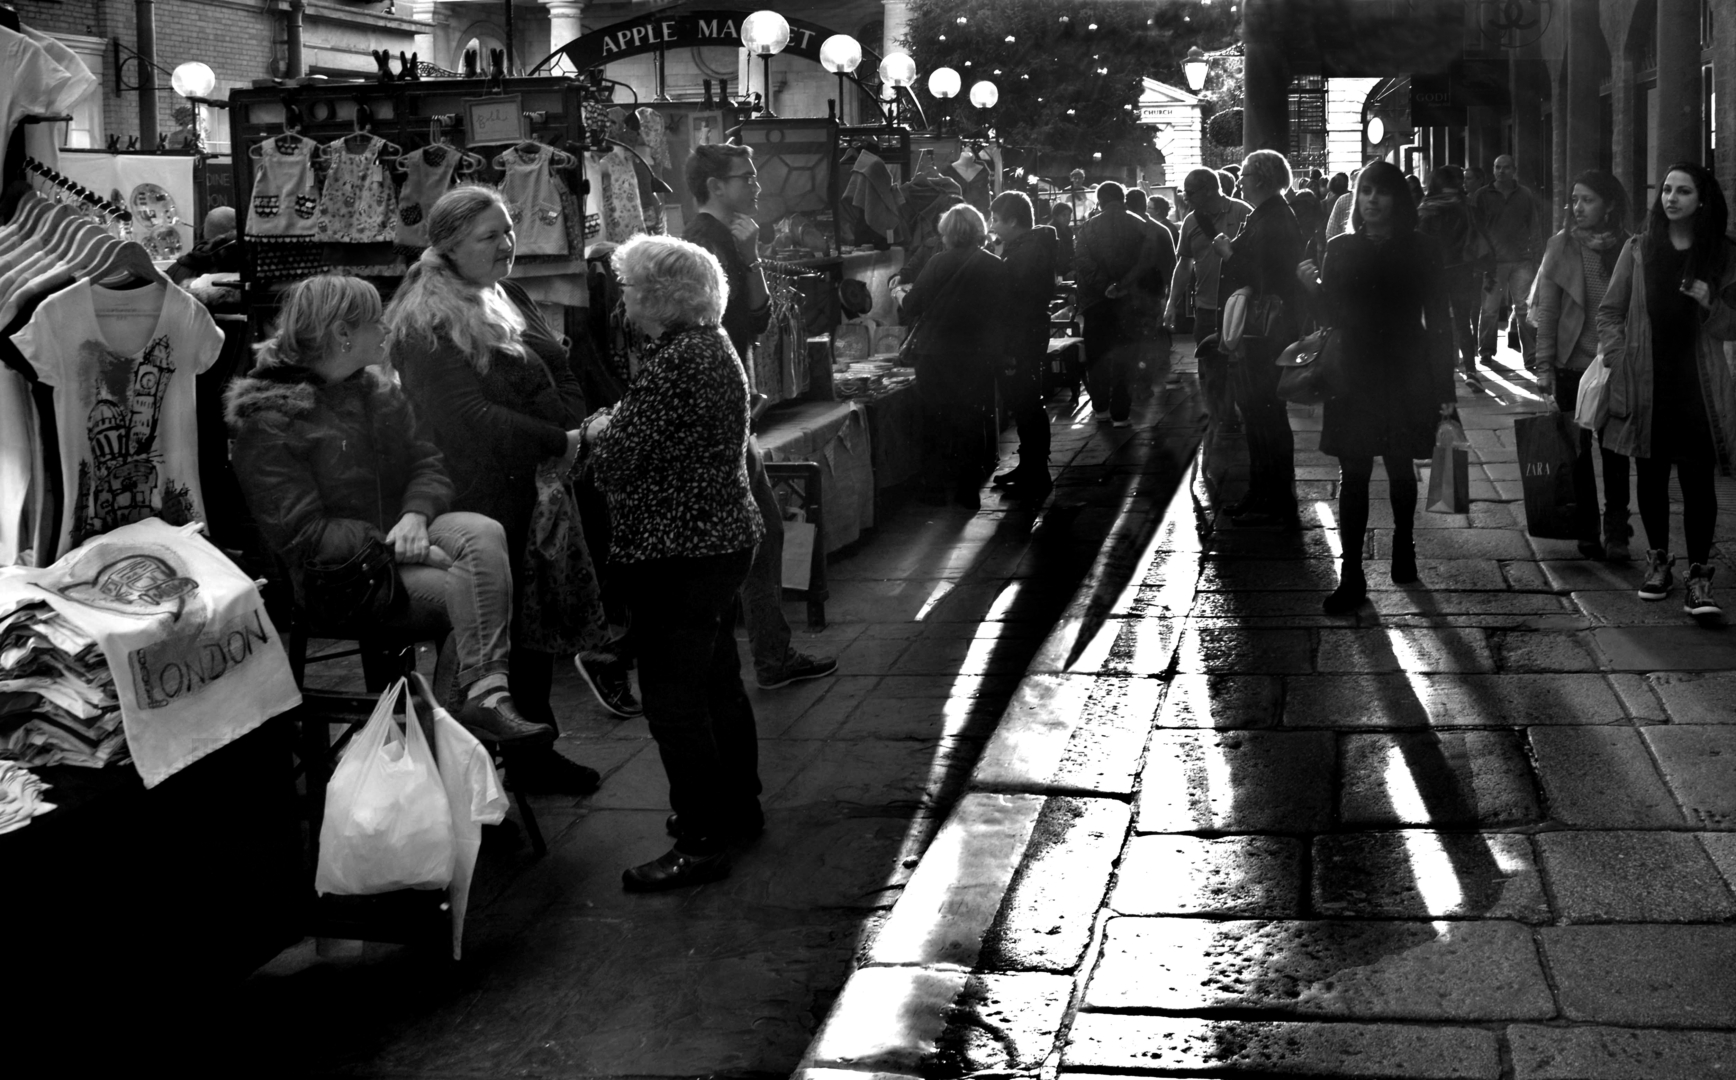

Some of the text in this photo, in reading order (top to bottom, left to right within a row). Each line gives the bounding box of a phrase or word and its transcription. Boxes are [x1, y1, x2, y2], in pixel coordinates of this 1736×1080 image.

[601, 18, 816, 57] APPLE MAET
[1415, 92, 1449, 102] GODI
[1525, 460, 1550, 476] ZARA
[135, 608, 268, 709] LONDON
